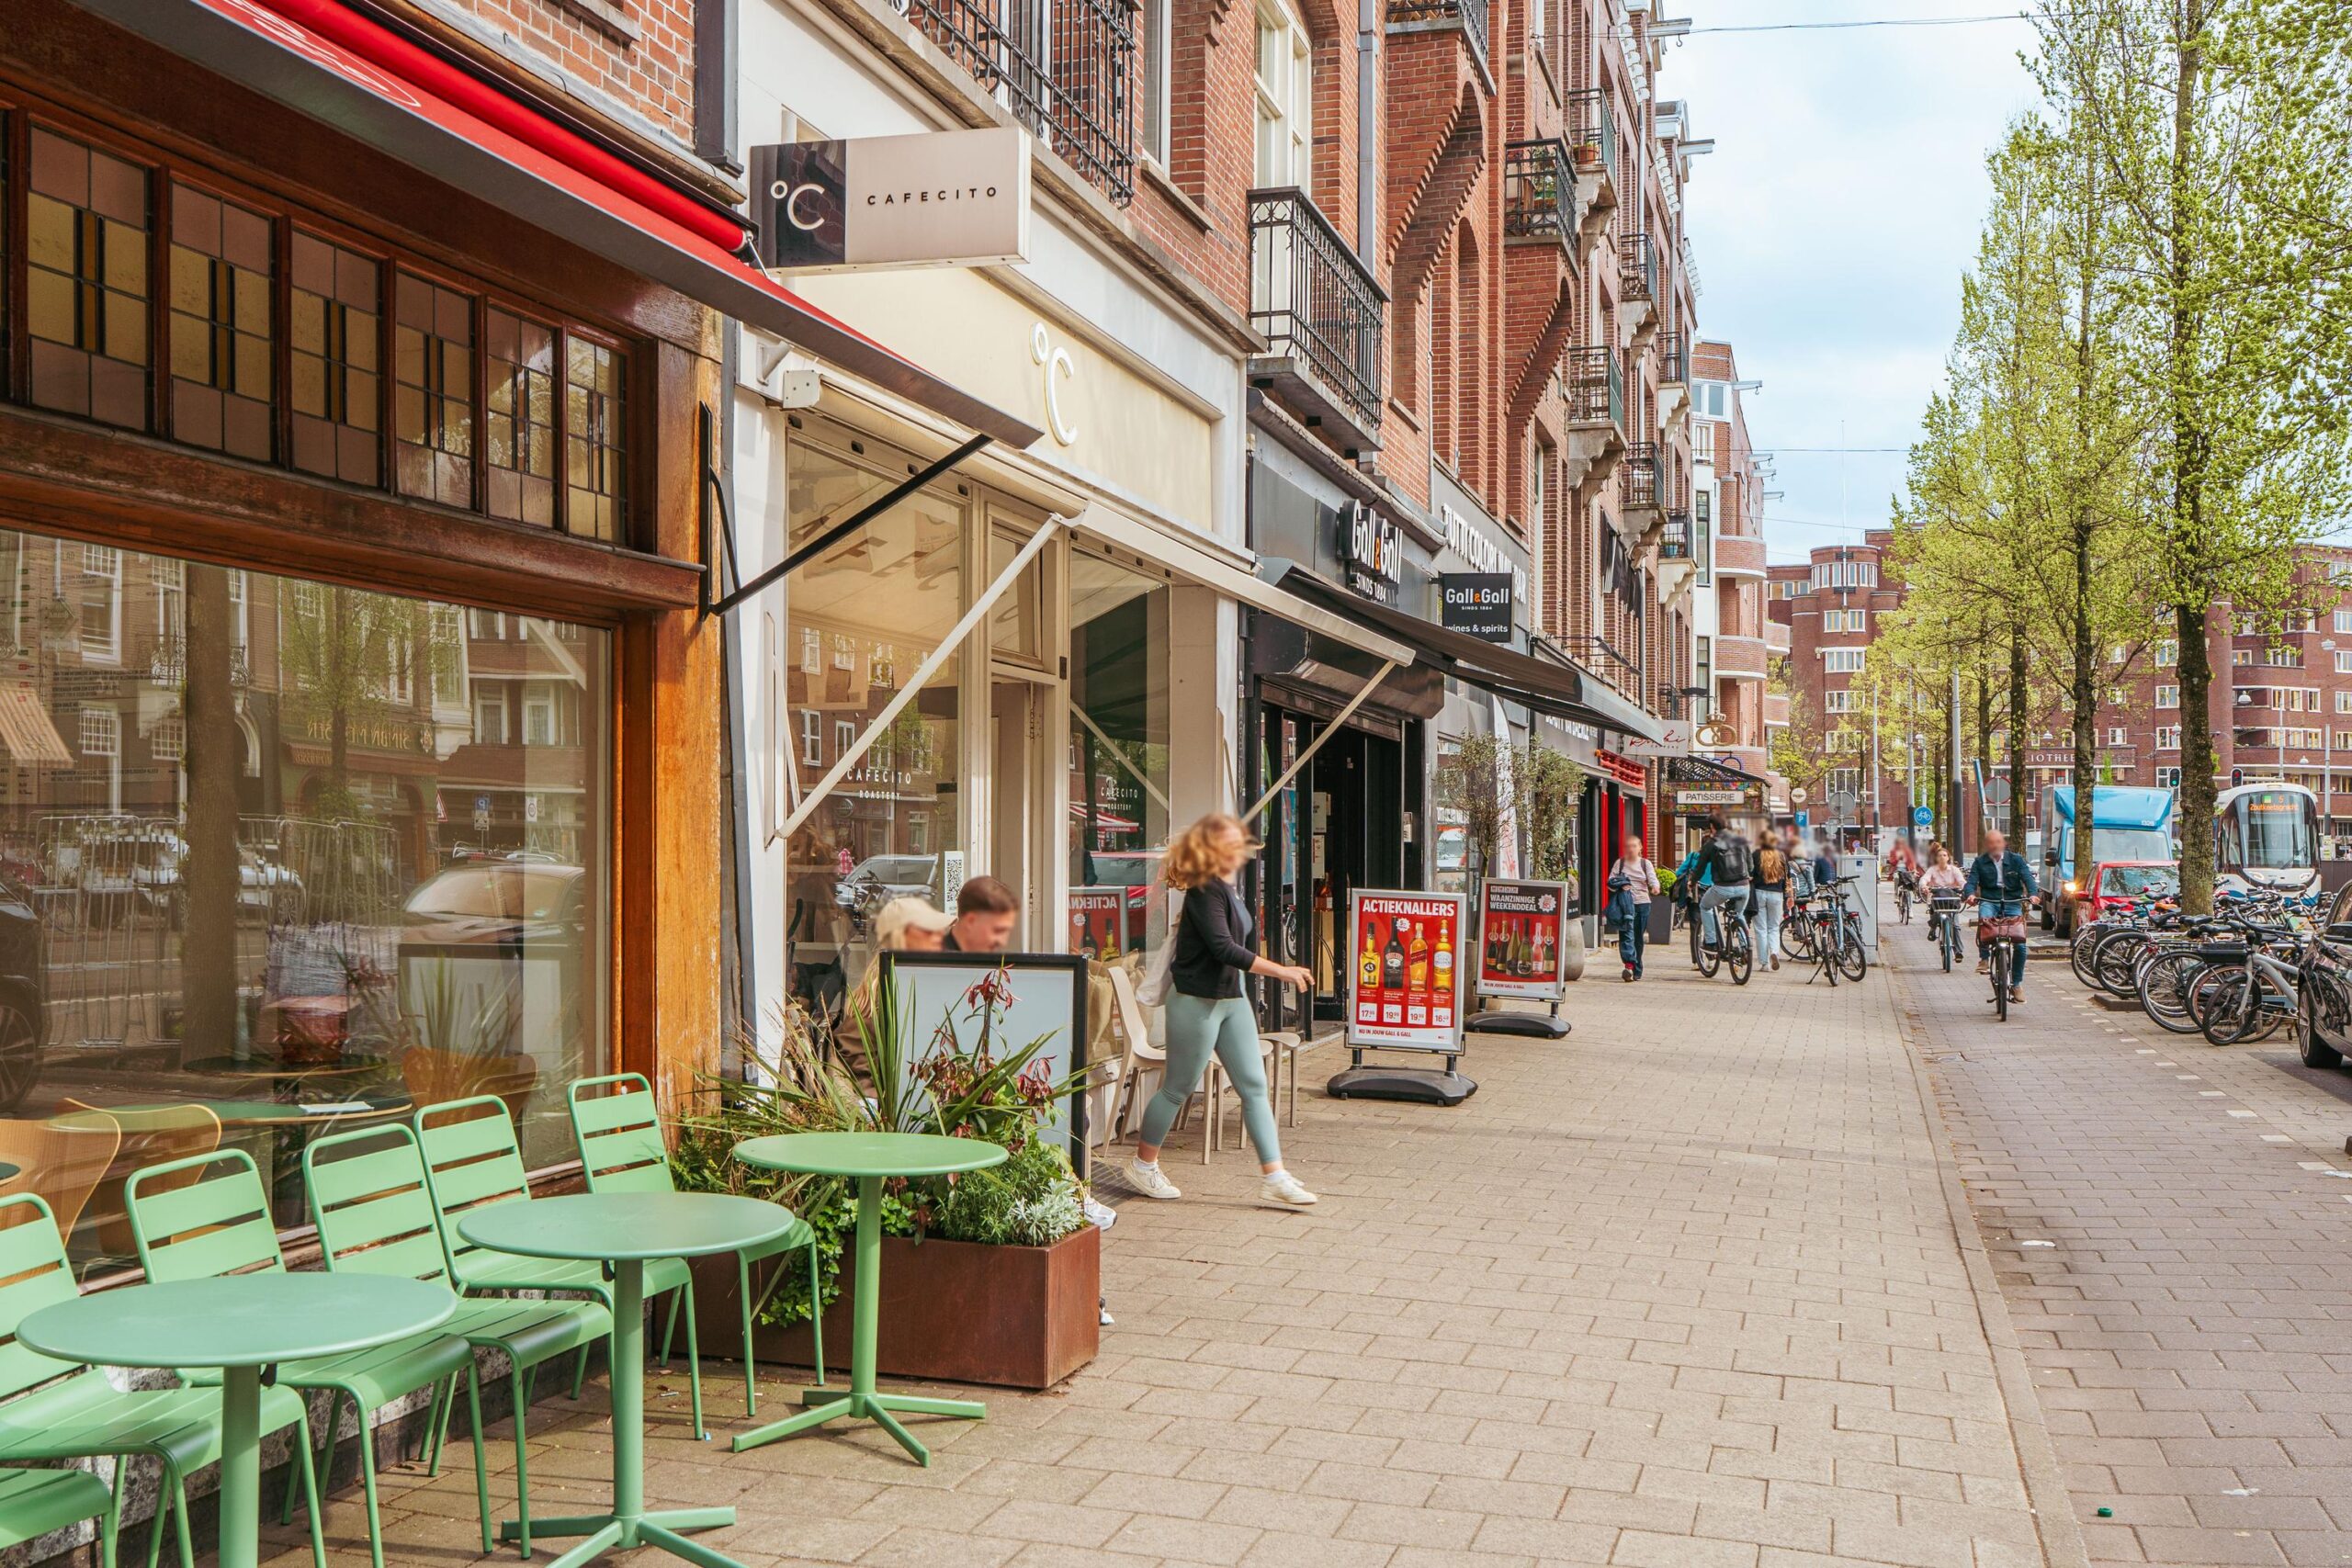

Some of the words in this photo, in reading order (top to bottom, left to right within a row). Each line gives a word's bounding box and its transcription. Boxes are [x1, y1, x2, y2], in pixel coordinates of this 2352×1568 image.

[867, 186, 998, 205] CAFECITO
[1443, 503, 1468, 555] TUTTI
[1469, 526, 1497, 574] COLORI
[1356, 572, 1373, 595] SINDS
[1374, 582, 1386, 602] 1884
[1472, 624, 1479, 632] &
[1481, 625, 1508, 634] spirits
[847, 768, 911, 784] CAFECITO
[859, 790, 900, 800] ROASTERY
[1685, 793, 1735, 801] PATISSERIE
[2278, 794, 2285, 803] 5
[1490, 894, 1536, 903] WAANZINNIGE
[1363, 899, 1455, 916] ACTIEKNALLERS
[1490, 902, 1538, 911] WEEKENDDEAL
